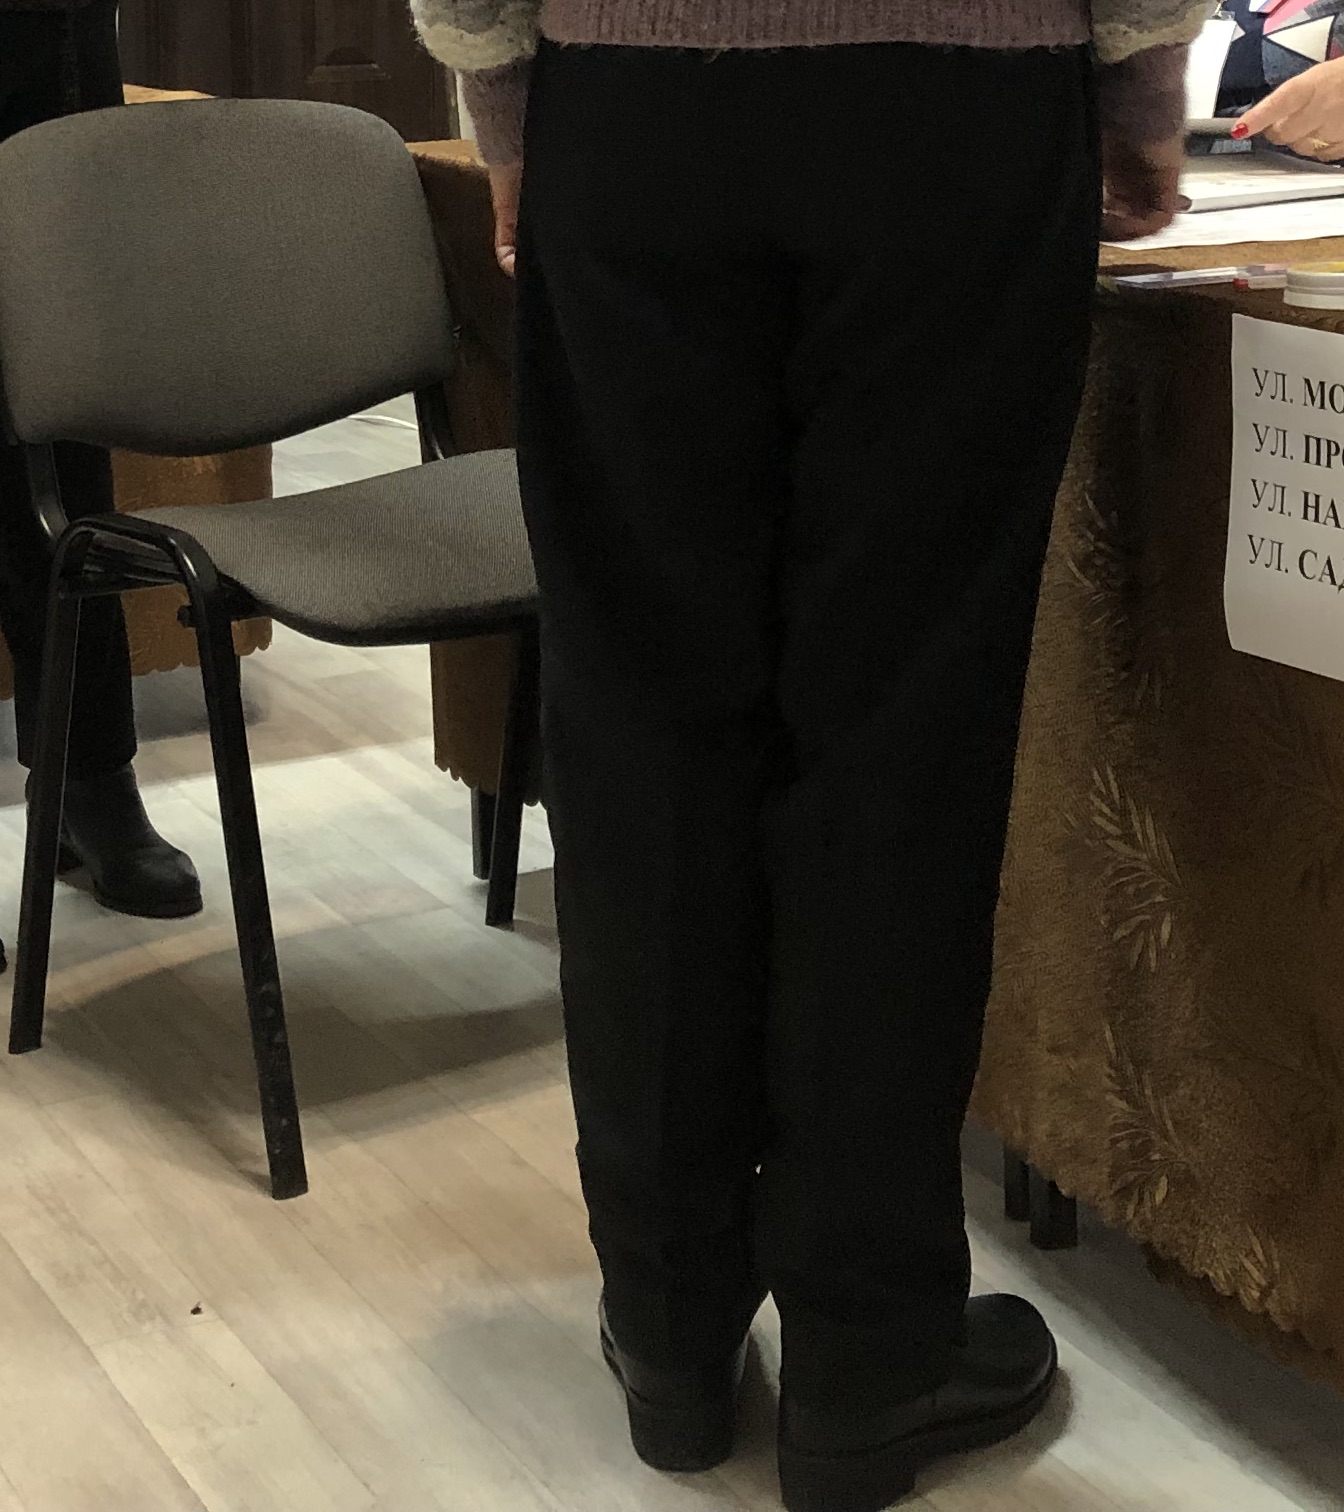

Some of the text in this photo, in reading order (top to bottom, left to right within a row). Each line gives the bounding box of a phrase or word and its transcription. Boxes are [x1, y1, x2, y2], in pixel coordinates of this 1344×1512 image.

[1252, 367, 1294, 406] УЛ.
[1252, 422, 1294, 461] УЛ.
[1250, 478, 1292, 517] УЛ.
[1247, 533, 1289, 574] УЛ.
